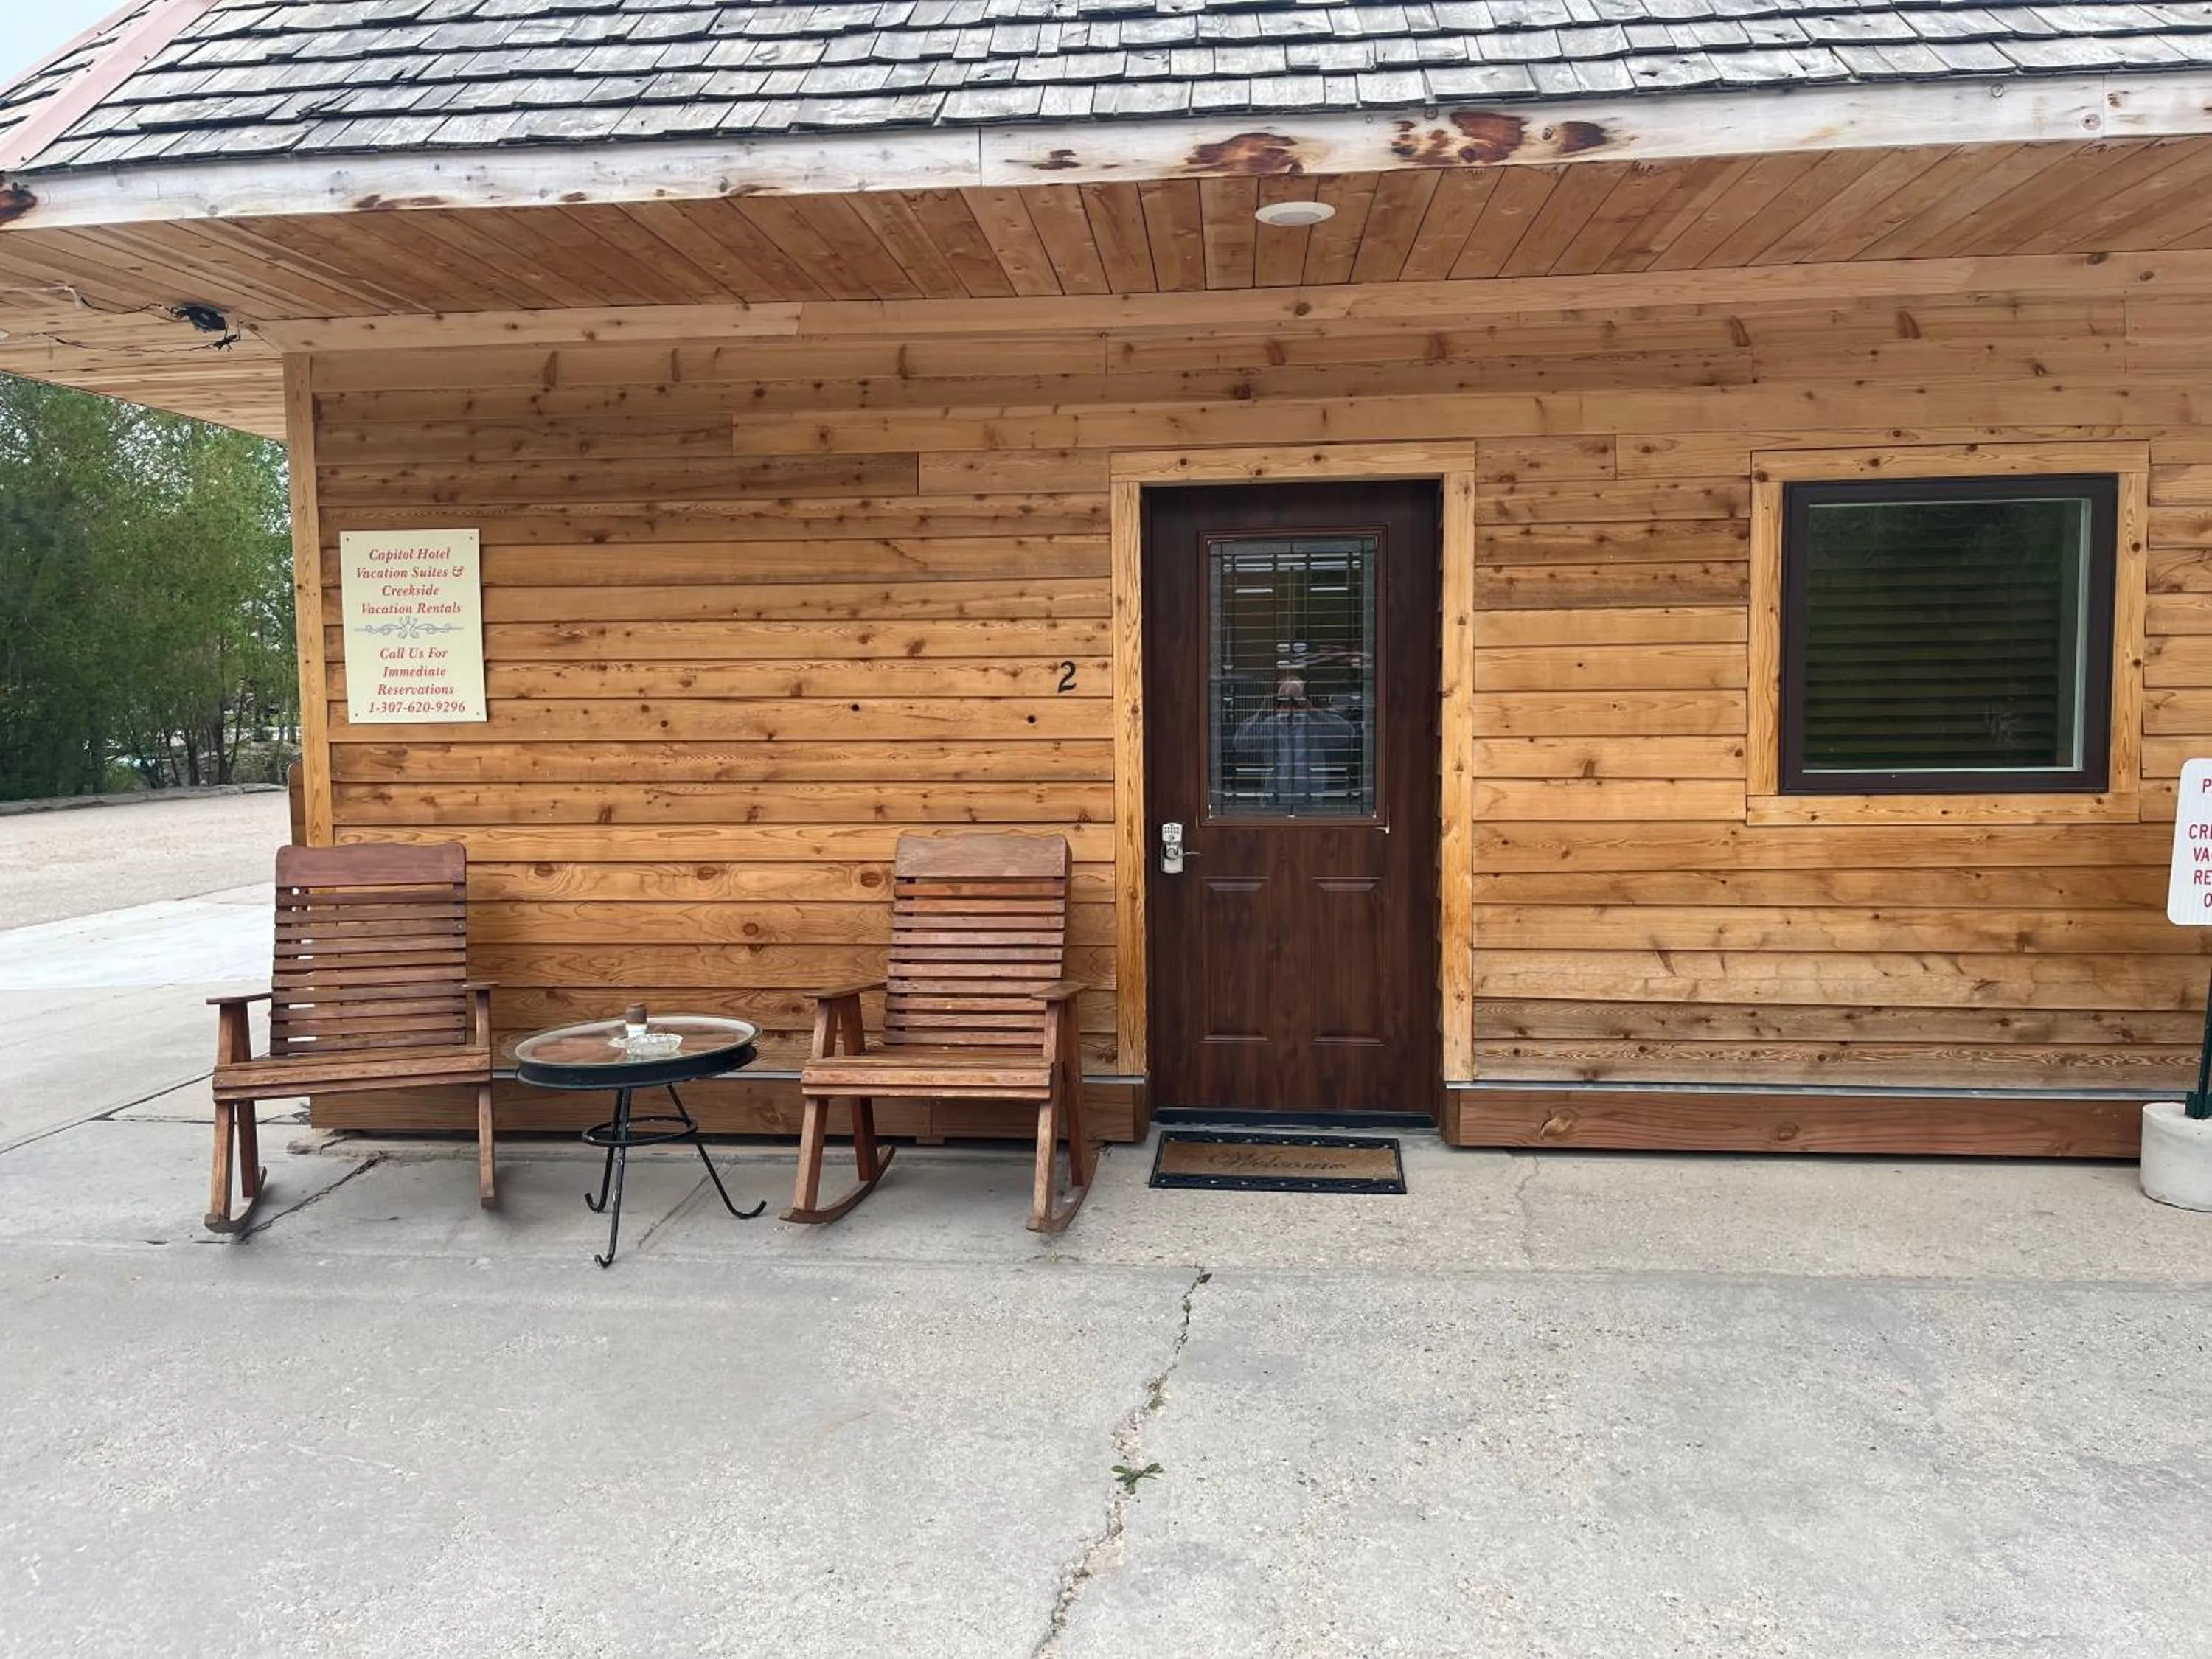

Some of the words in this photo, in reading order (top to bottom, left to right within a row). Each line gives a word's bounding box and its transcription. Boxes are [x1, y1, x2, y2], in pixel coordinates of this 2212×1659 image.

[369, 549, 414, 563] Capitol
[417, 547, 451, 560] Hotel
[356, 567, 408, 579] Vacation
[411, 566, 448, 578] Suites
[451, 566, 465, 577] &
[381, 584, 439, 597] Creekside
[361, 603, 413, 614] Vacation
[417, 602, 462, 614] Rentals
[380, 647, 404, 659] Call
[408, 647, 424, 659] Us
[428, 647, 448, 658] For
[383, 665, 447, 678] Immediate
[1057, 661, 1077, 693] 2
[377, 684, 455, 696] Reservations
[369, 700, 466, 714] 1-307-620-9296
[2202, 778, 2212, 793] P
[2193, 847, 2212, 861] VA
